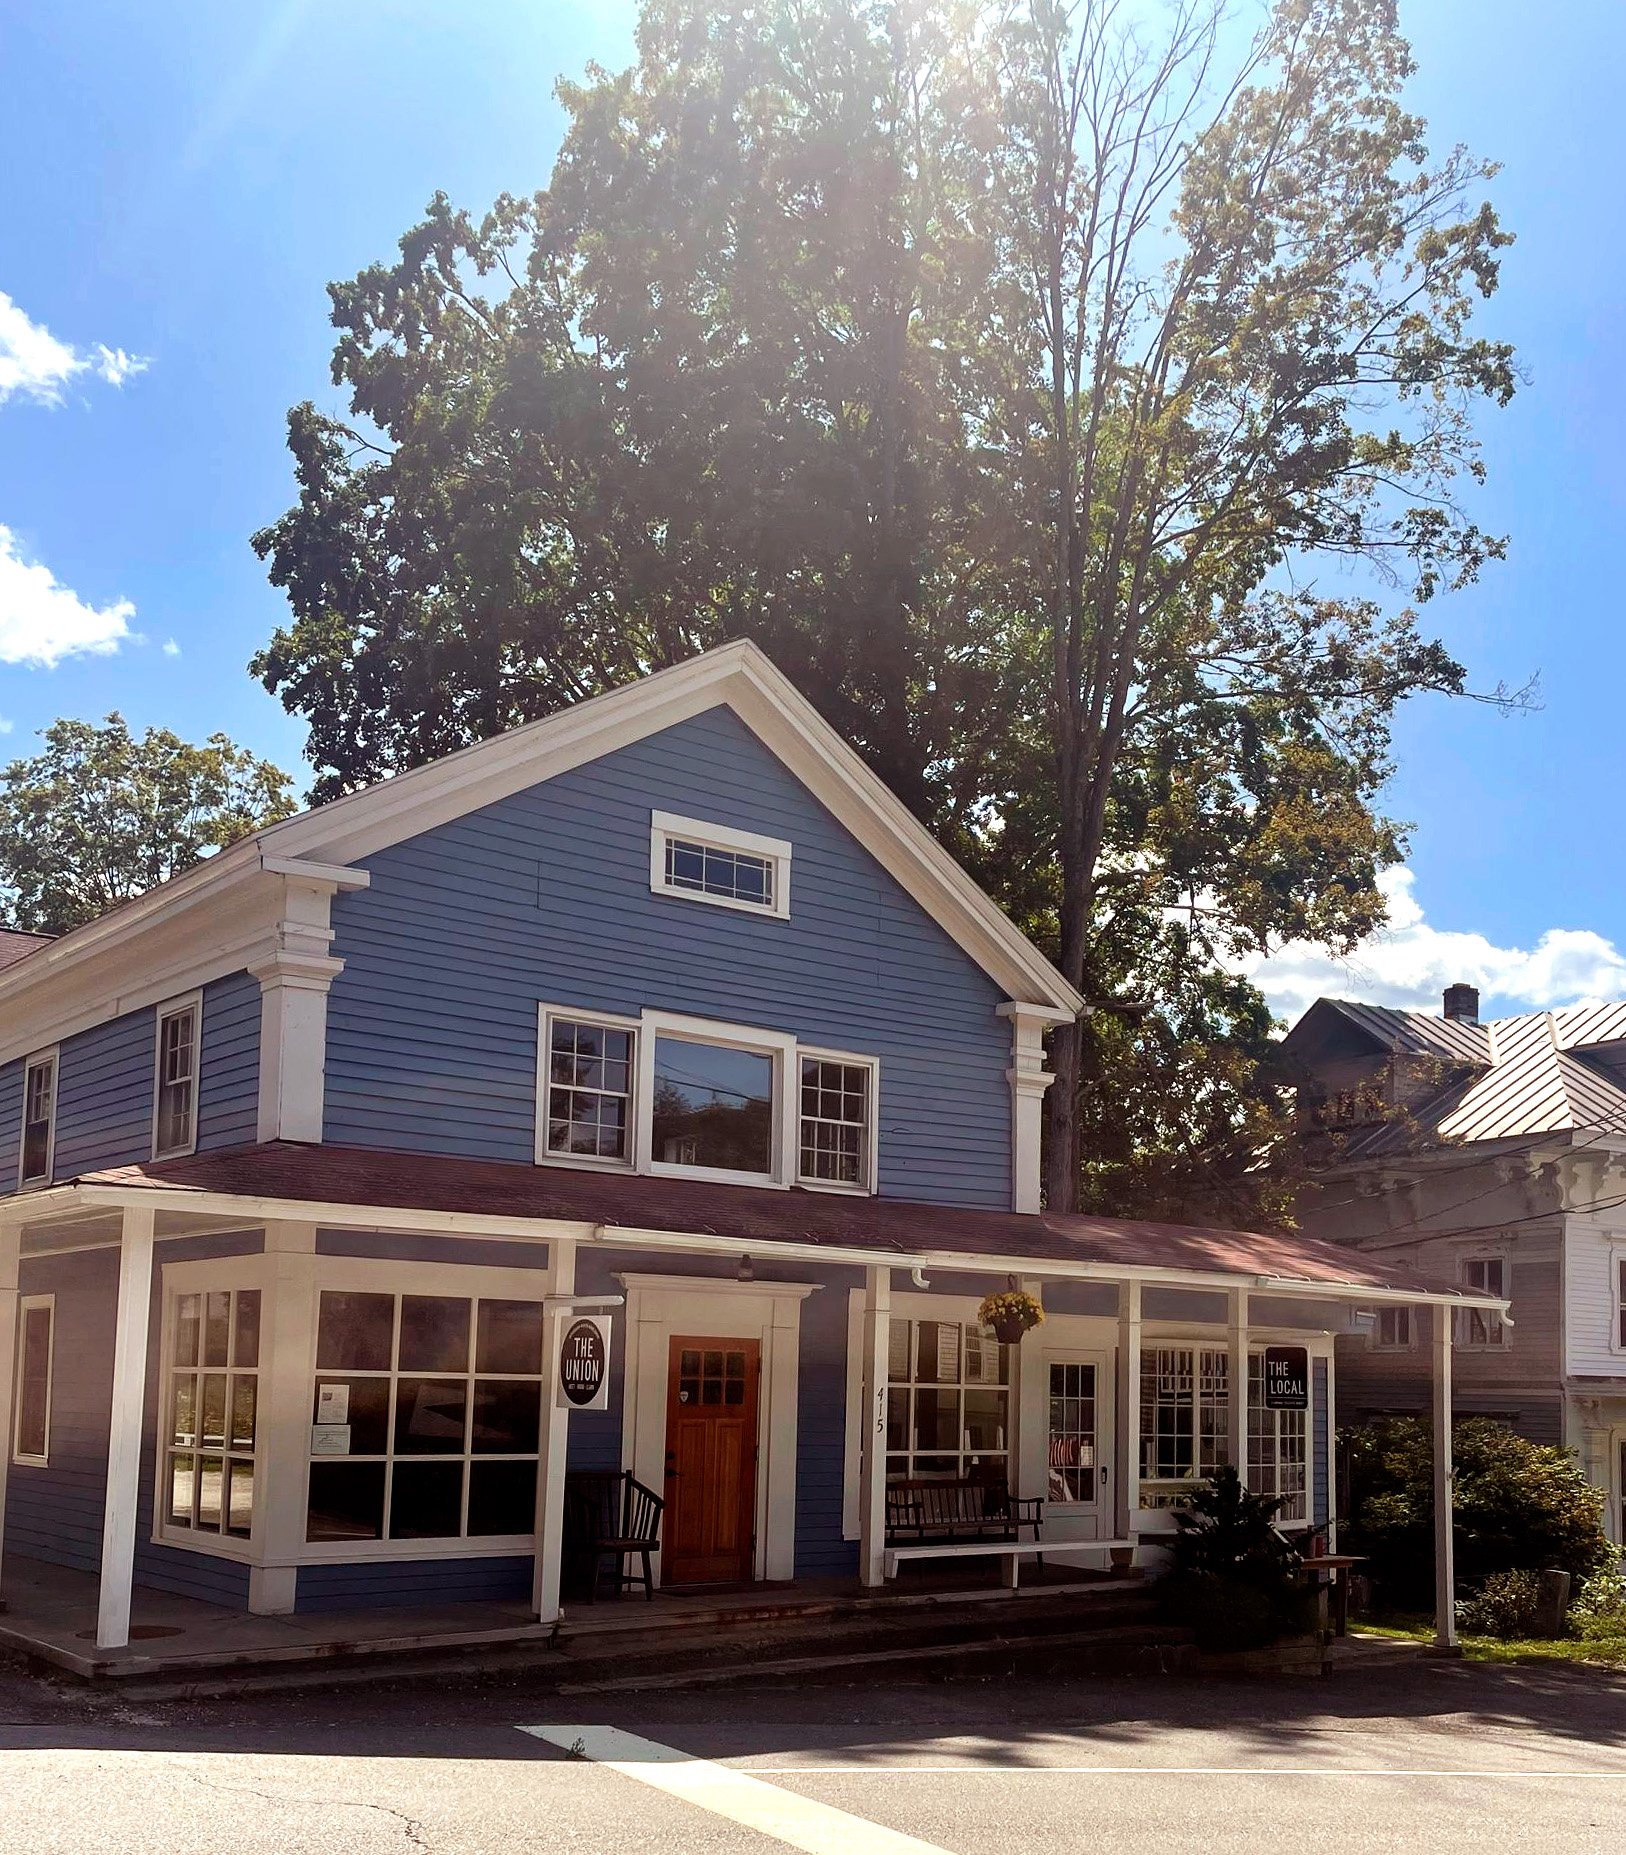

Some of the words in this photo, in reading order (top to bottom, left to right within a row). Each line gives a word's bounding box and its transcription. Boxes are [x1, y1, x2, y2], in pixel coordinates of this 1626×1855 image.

[574, 1337, 594, 1358] THE
[565, 1359, 599, 1382] UNION
[1268, 1361, 1289, 1376] THE
[1270, 1379, 1305, 1395] LOCAL
